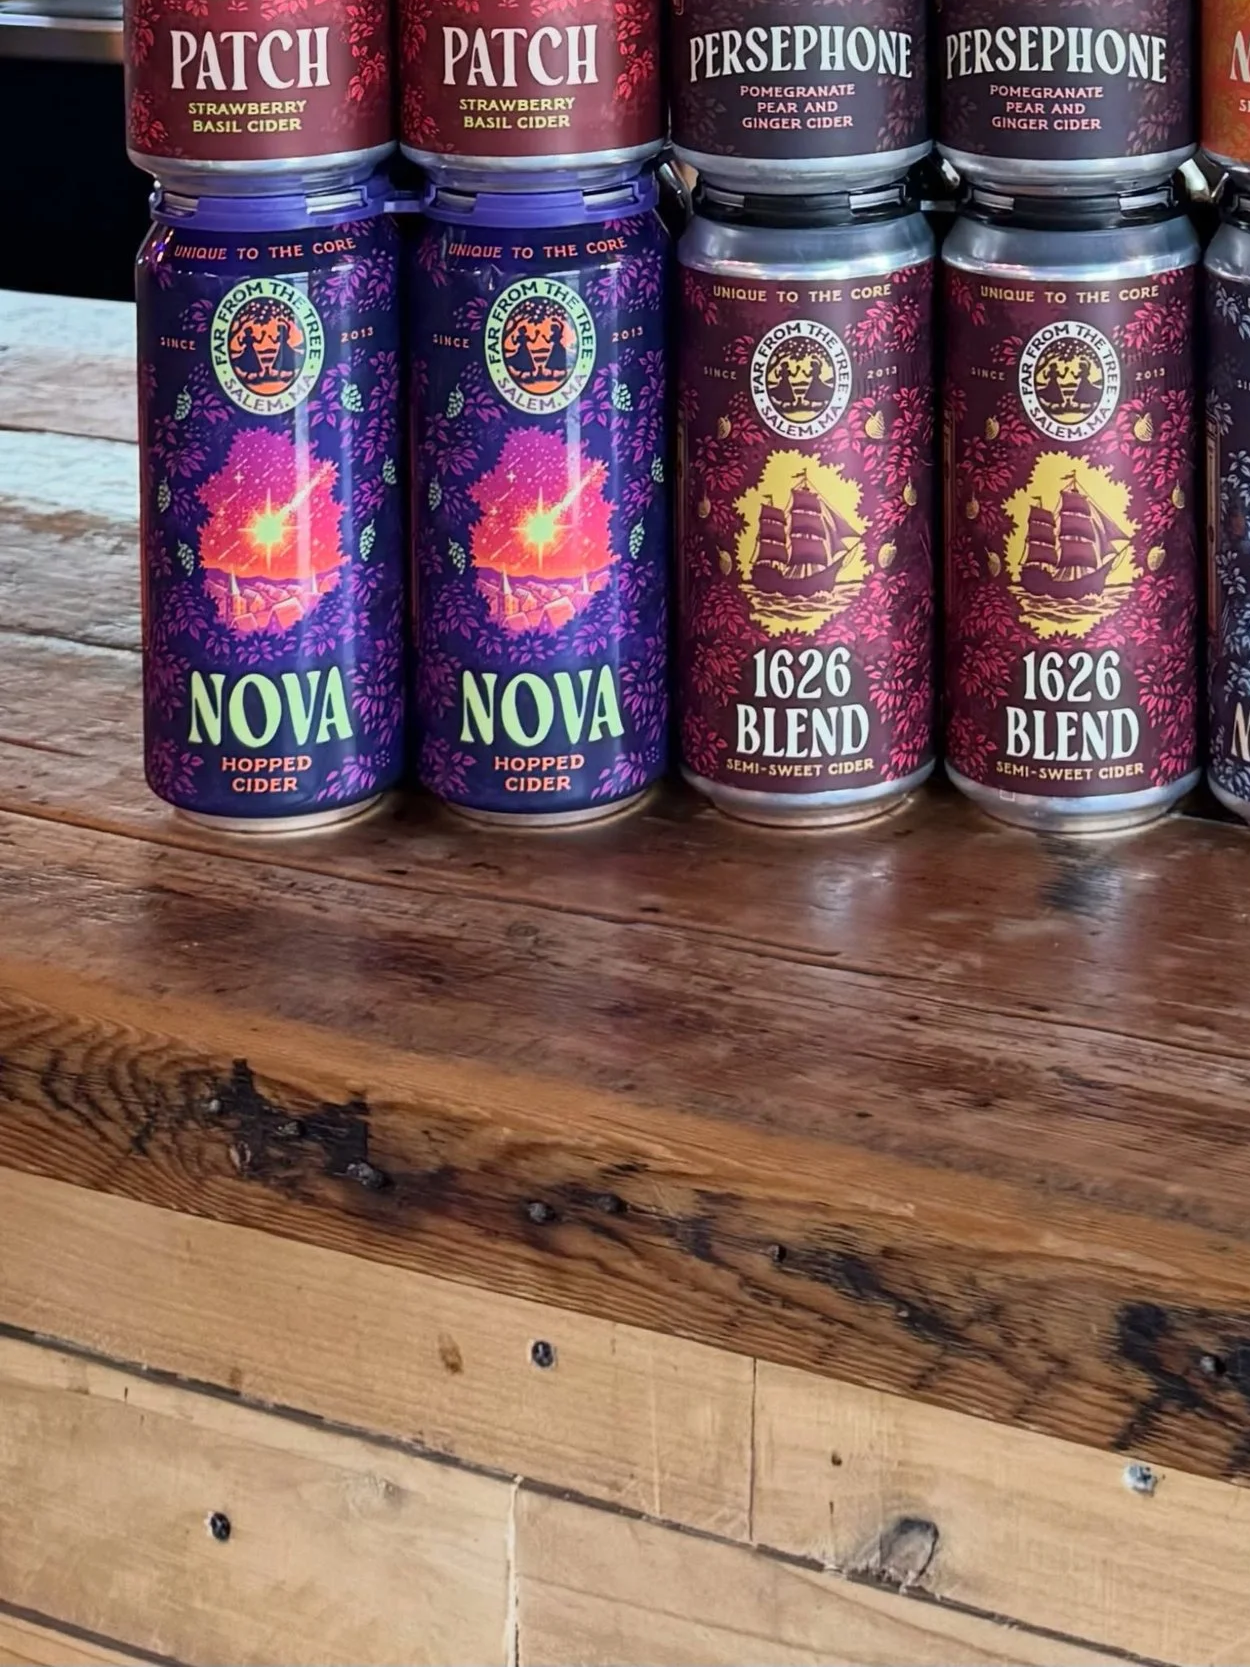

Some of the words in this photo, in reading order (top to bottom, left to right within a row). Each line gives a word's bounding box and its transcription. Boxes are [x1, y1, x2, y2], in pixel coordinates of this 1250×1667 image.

[170, 26, 331, 91] PATCH
[442, 24, 599, 87] PATCH
[689, 25, 912, 83] PERSEPHONE
[946, 26, 1167, 84] PERSEPHONE
[740, 84, 856, 98] POMEGRANATE
[990, 84, 1104, 99] POMEGRANATE
[188, 99, 307, 116] STRAWBERRY
[459, 97, 576, 112] STRAWBERRY
[757, 101, 798, 114] PEAR
[804, 100, 839, 113] AND
[1006, 102, 1045, 114] PEAR
[1051, 103, 1086, 115] AND
[192, 120, 242, 134] BASIL
[247, 118, 302, 132] CIDER
[463, 116, 512, 129] BASIL
[516, 114, 571, 129] CIDER
[742, 117, 802, 130] GINGER
[806, 115, 854, 129] CIDER
[991, 116, 1049, 130] GINGER
[1053, 118, 1102, 131] CIDER
[753, 647, 851, 699] 1626
[1022, 650, 1121, 703] 1626
[188, 665, 354, 748] NOVA
[460, 664, 625, 747] NOVA
[736, 704, 869, 758] BLEND
[1005, 706, 1140, 762] BLEND
[221, 755, 313, 773] HOPPED
[494, 754, 585, 771] HOPPED
[726, 758, 823, 777] SEMI-SWEET
[828, 758, 875, 775] CIDER
[996, 761, 1092, 780] SEMI-SWEET
[1098, 762, 1144, 780] CIDER
[232, 777, 298, 793] CIDER
[505, 776, 572, 792] CIDER
